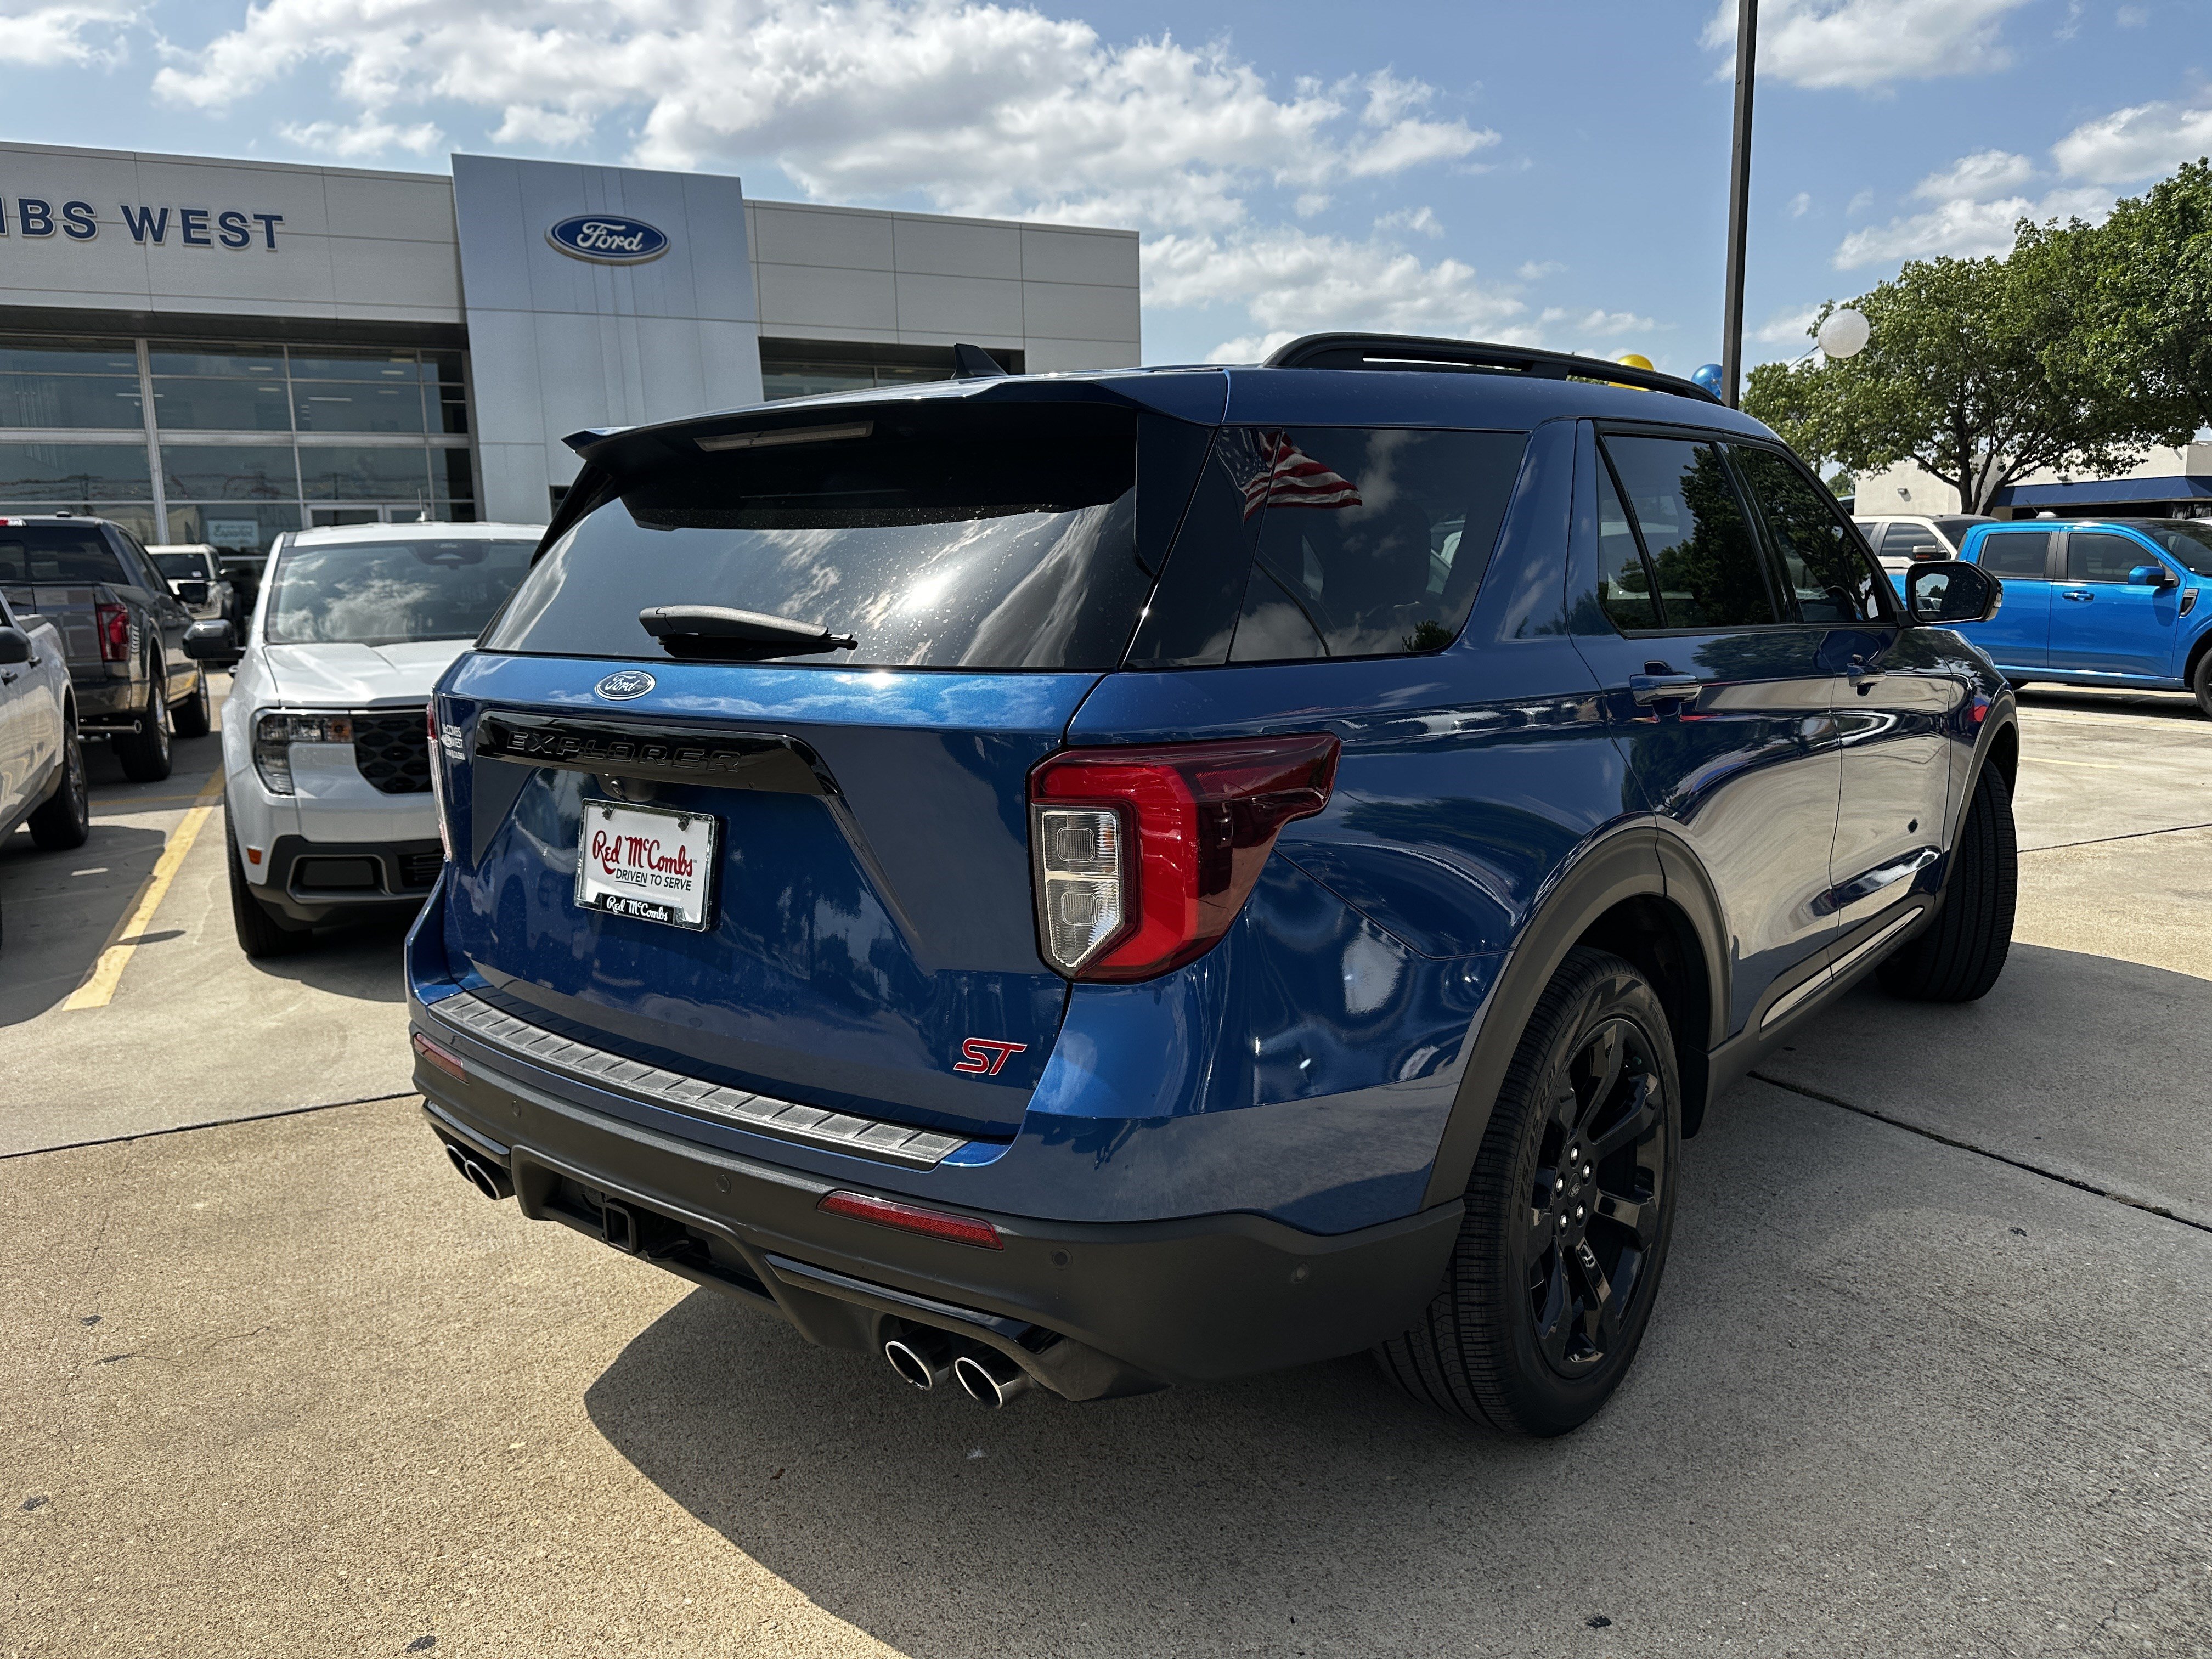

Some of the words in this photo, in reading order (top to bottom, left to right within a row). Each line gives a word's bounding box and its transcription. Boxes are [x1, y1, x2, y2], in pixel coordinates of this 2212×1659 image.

[0, 196, 98, 241] BS
[119, 204, 285, 251] WEST
[576, 221, 644, 251] Ford
[605, 674, 641, 692] Ford
[506, 730, 741, 772] EXPLORER
[592, 830, 622, 875] Red
[624, 834, 693, 877] McCombs
[616, 868, 648, 884] DRIVEN
[650, 873, 662, 887] TO
[663, 876, 692, 891] SERVE
[606, 895, 625, 914] Red
[627, 898, 668, 922] McCombs
[953, 1037, 1028, 1076] ST
